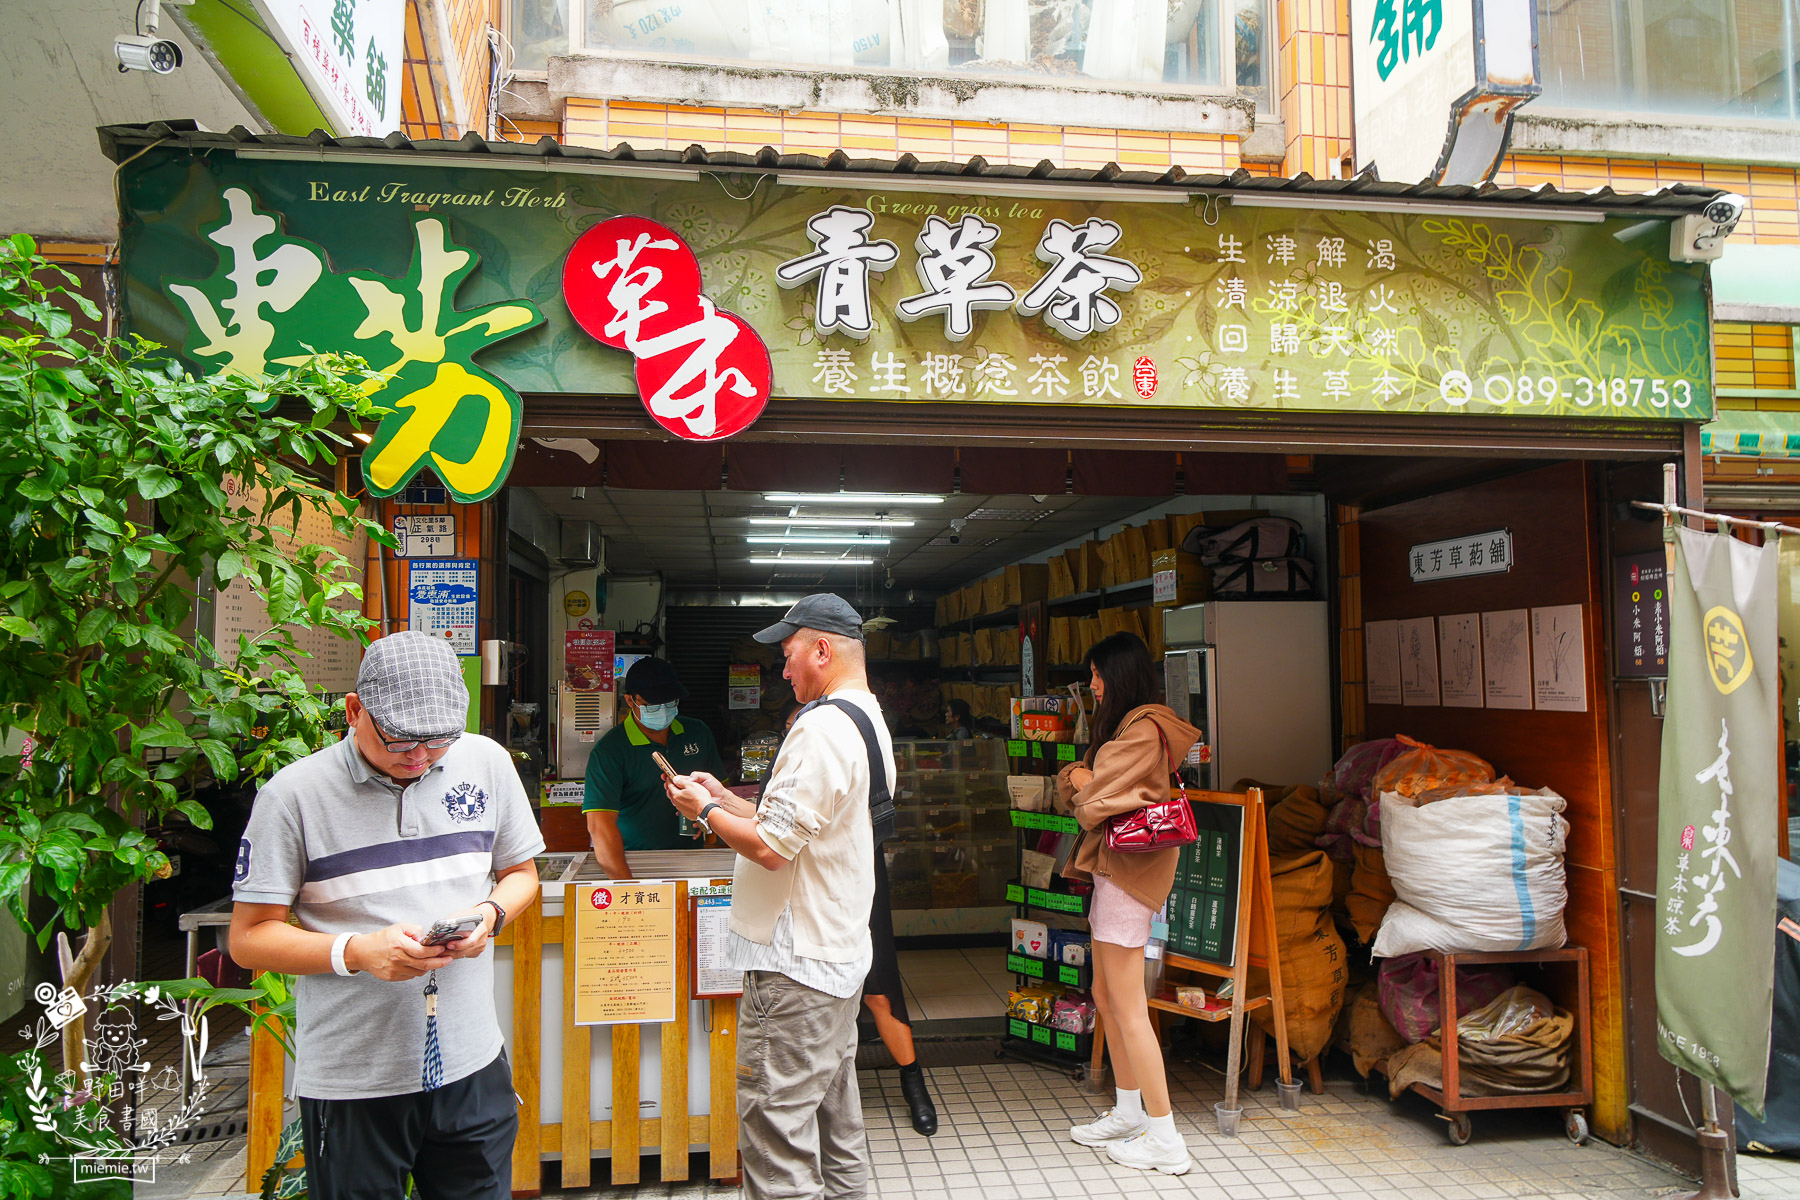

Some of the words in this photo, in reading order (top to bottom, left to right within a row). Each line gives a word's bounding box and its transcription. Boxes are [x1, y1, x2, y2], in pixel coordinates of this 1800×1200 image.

[308, 181, 371, 203] East
[377, 182, 494, 208] Fragrant
[501, 186, 566, 208] Herb
[866, 194, 940, 216] Green
[946, 202, 1001, 221] grass
[1008, 202, 1045, 219] tea
[776, 205, 1143, 341] 青草茶
[1216, 277, 1398, 313] 清涼退火
[1219, 323, 1399, 356] 回歸天然
[812, 348, 1123, 400] 養生概念茶飲
[1219, 366, 1402, 401] 養生草本
[1484, 374, 1692, 410] 089-318753
[413, 524, 447, 533] 正氣路
[427, 543, 434, 555] 1
[619, 891, 661, 905] 才資訊
